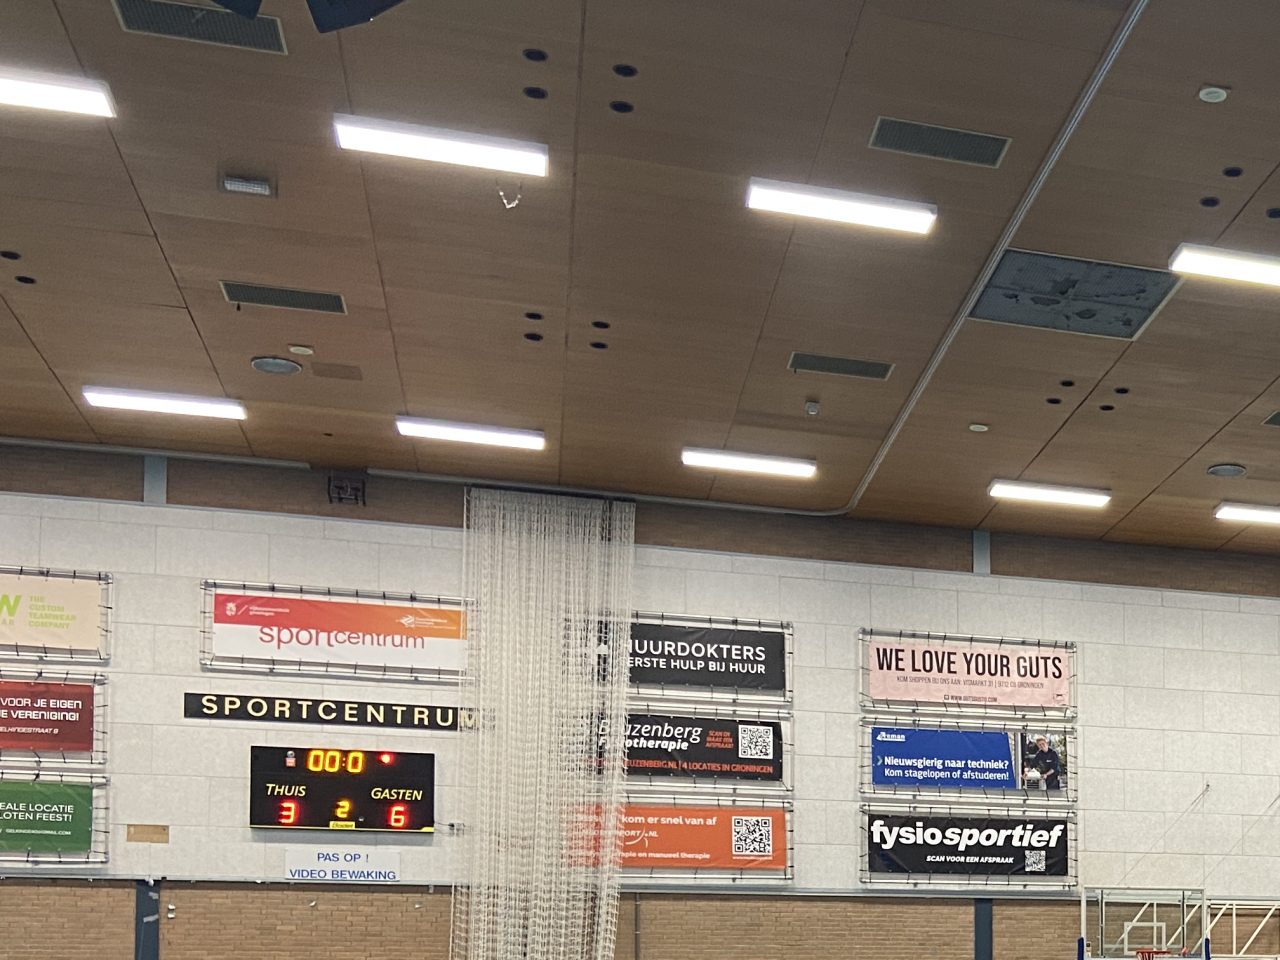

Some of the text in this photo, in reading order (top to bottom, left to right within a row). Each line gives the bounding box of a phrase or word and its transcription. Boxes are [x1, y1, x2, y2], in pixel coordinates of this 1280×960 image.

[628, 658, 766, 674] ERSTE HULP BIJ HUUR
[876, 647, 1062, 679] WE LOVE YOUR GUTS
[34, 699, 47, 708] JE
[49, 700, 82, 709] EIGEN
[11, 710, 79, 721] VERENIGING!
[884, 756, 1009, 769] Nieuwsgierig naar techniek?
[884, 768, 1009, 781] Kom stagelopen of afstuderen!
[266, 784, 423, 800] THUIS GASTEN
[29, 804, 74, 813] LOCATIE
[280, 801, 405, 827] 3 2 6
[36, 813, 72, 822] FEEST!
[622, 816, 645, 824] kom
[660, 816, 683, 825] snel
[706, 817, 717, 825] af
[870, 820, 1065, 852] fysiosportief
[317, 853, 339, 862] PAS
[344, 853, 361, 863] OP
[680, 852, 710, 860] therapie
[290, 869, 396, 880] VIDEO BEWAKING
